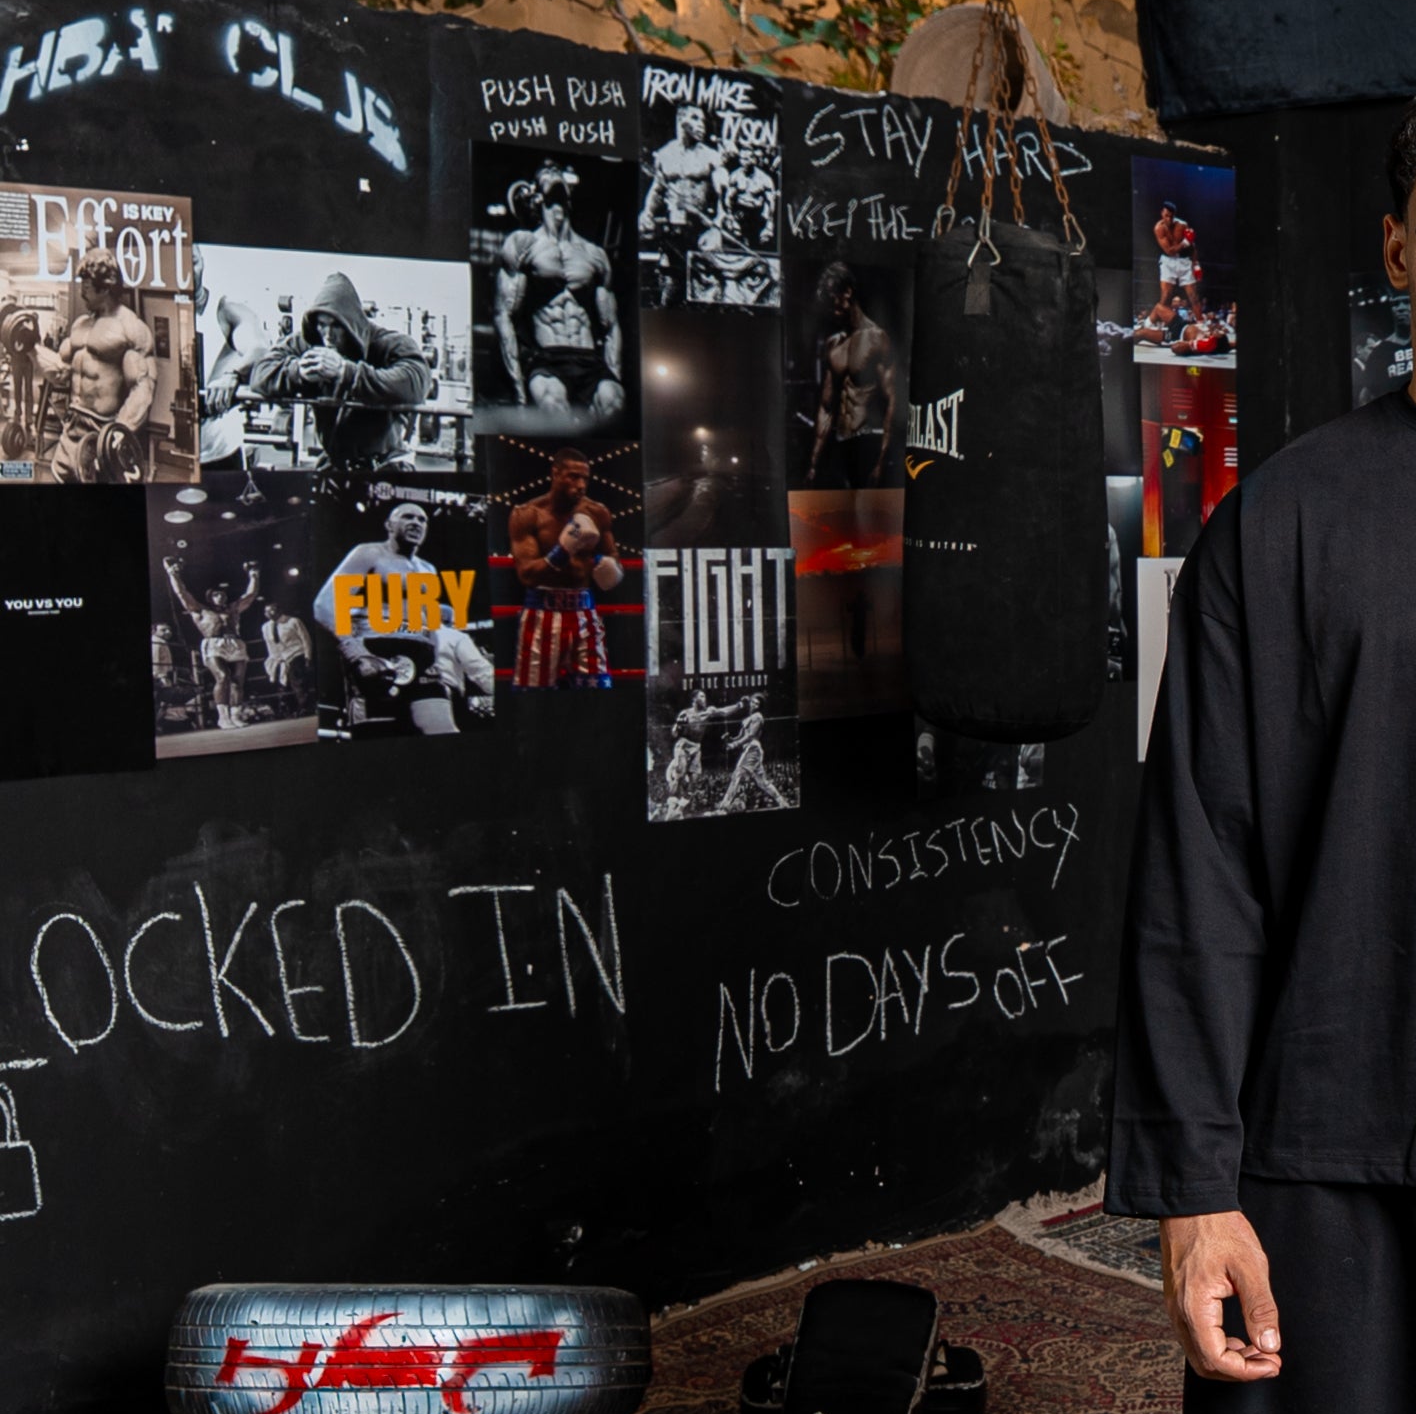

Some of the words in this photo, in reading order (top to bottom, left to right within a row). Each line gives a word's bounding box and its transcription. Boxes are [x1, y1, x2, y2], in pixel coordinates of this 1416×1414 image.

[481, 74, 556, 113] PUSH
[567, 76, 627, 112] PUSH
[642, 65, 697, 109] IRON
[490, 115, 548, 142] PUSH
[558, 119, 616, 146] PUSH
[805, 103, 933, 179] STAY
[956, 119, 1093, 182] HARD
[30, 193, 191, 291] Effort
[122, 203, 140, 219] IS
[141, 205, 175, 223] KEY
[1387, 360, 1413, 377] REA
[5, 599, 33, 610] YOU
[35, 599, 53, 609] VS
[55, 597, 83, 608] YOU
[333, 570, 476, 636] FURY
[642, 548, 796, 676] FIGHT
[768, 802, 1080, 907] CONSISTENCY
[0, 880, 420, 1069] OCKED
[448, 873, 625, 1017] IN
[716, 968, 800, 1092] NO
[827, 933, 980, 1056] DAYS
[994, 936, 1084, 1019] OFF
